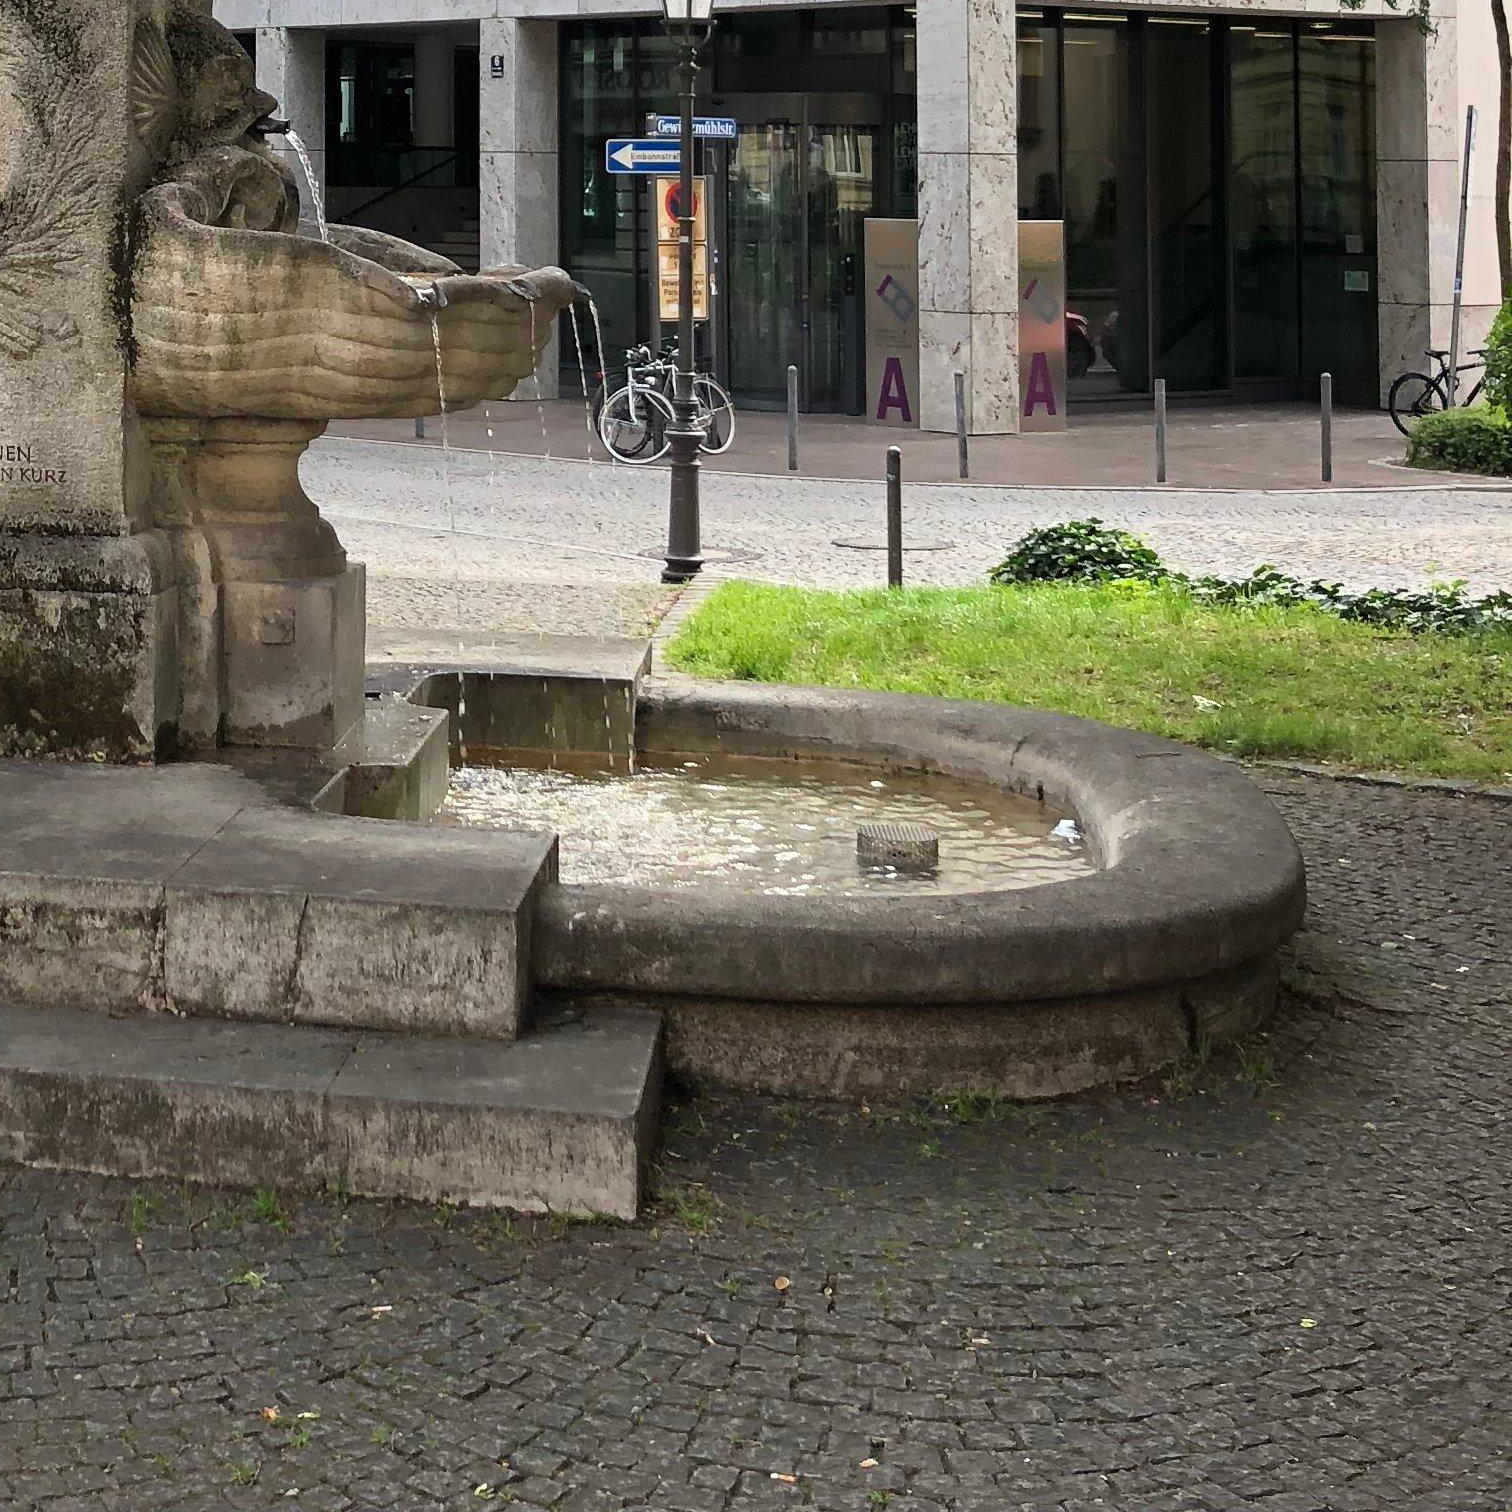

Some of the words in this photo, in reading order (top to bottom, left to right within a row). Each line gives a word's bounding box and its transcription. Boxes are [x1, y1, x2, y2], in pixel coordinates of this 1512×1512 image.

[876, 357, 912, 422] A
[1022, 351, 1057, 417] A
[20, 468, 67, 484] KURZ
